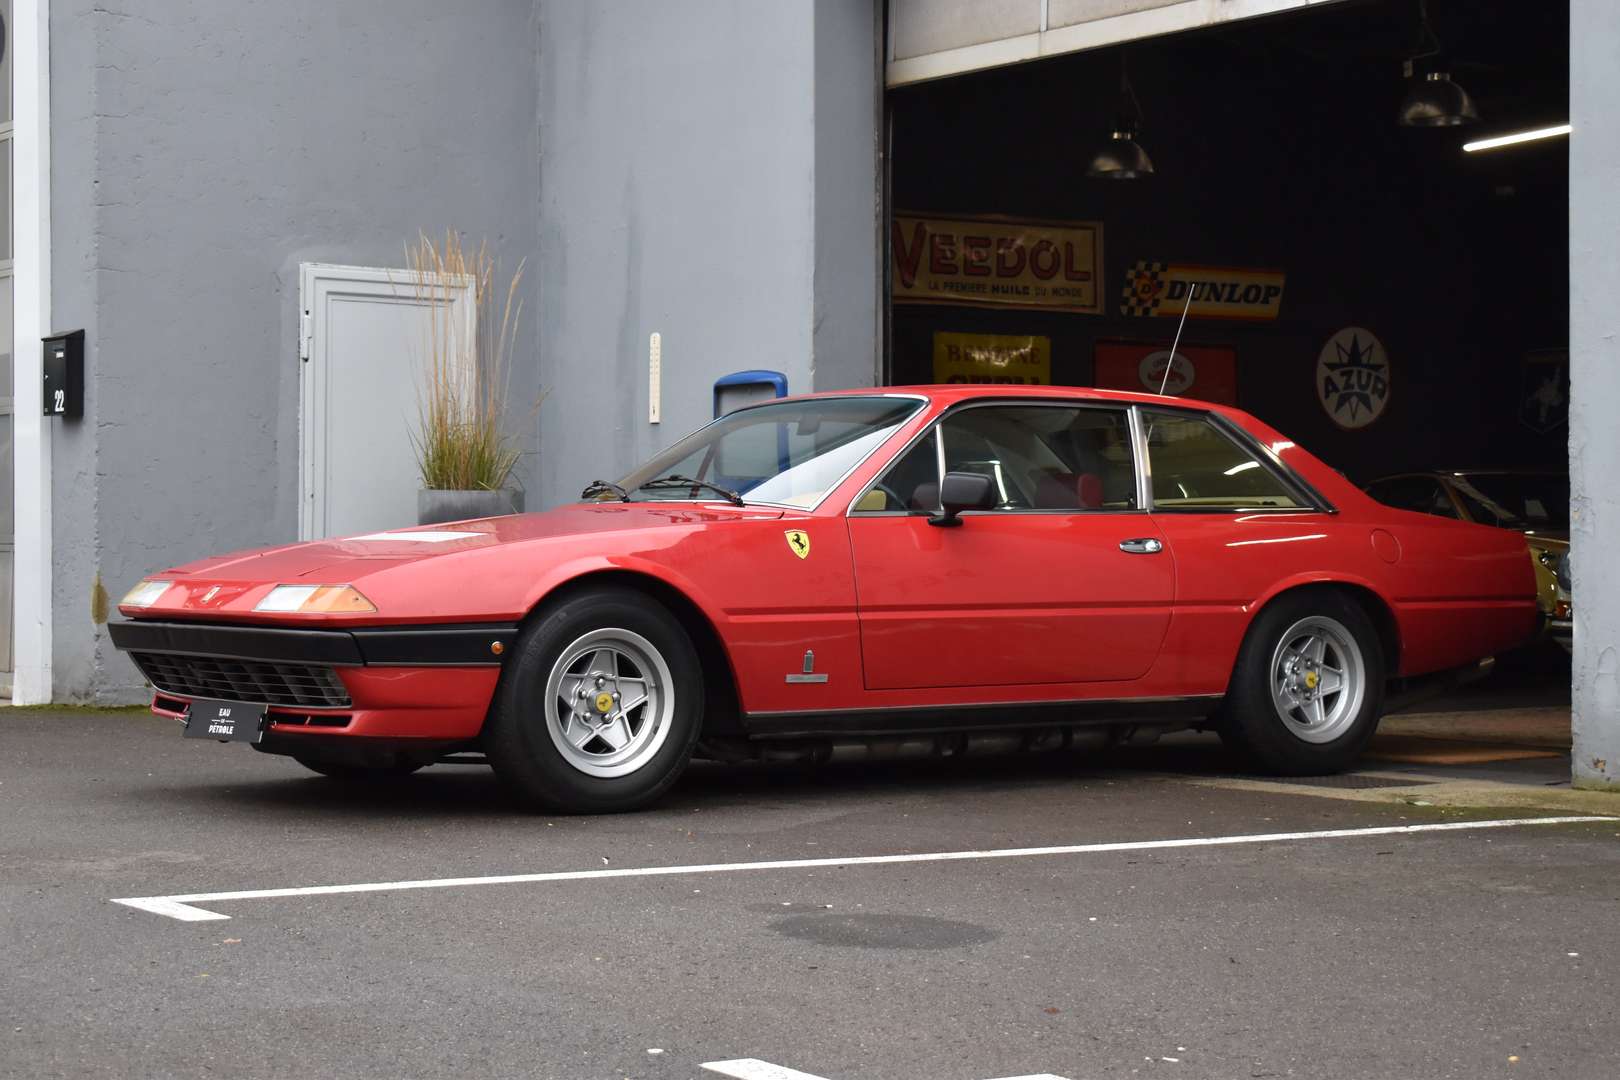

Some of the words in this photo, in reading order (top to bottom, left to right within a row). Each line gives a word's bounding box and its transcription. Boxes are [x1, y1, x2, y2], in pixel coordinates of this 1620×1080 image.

[893, 220, 1092, 289] VEEDOL
[1165, 279, 1281, 305] DUNLOP
[1323, 369, 1387, 401] AZUR
[54, 389, 65, 413] 22
[218, 708, 232, 717] EAU
